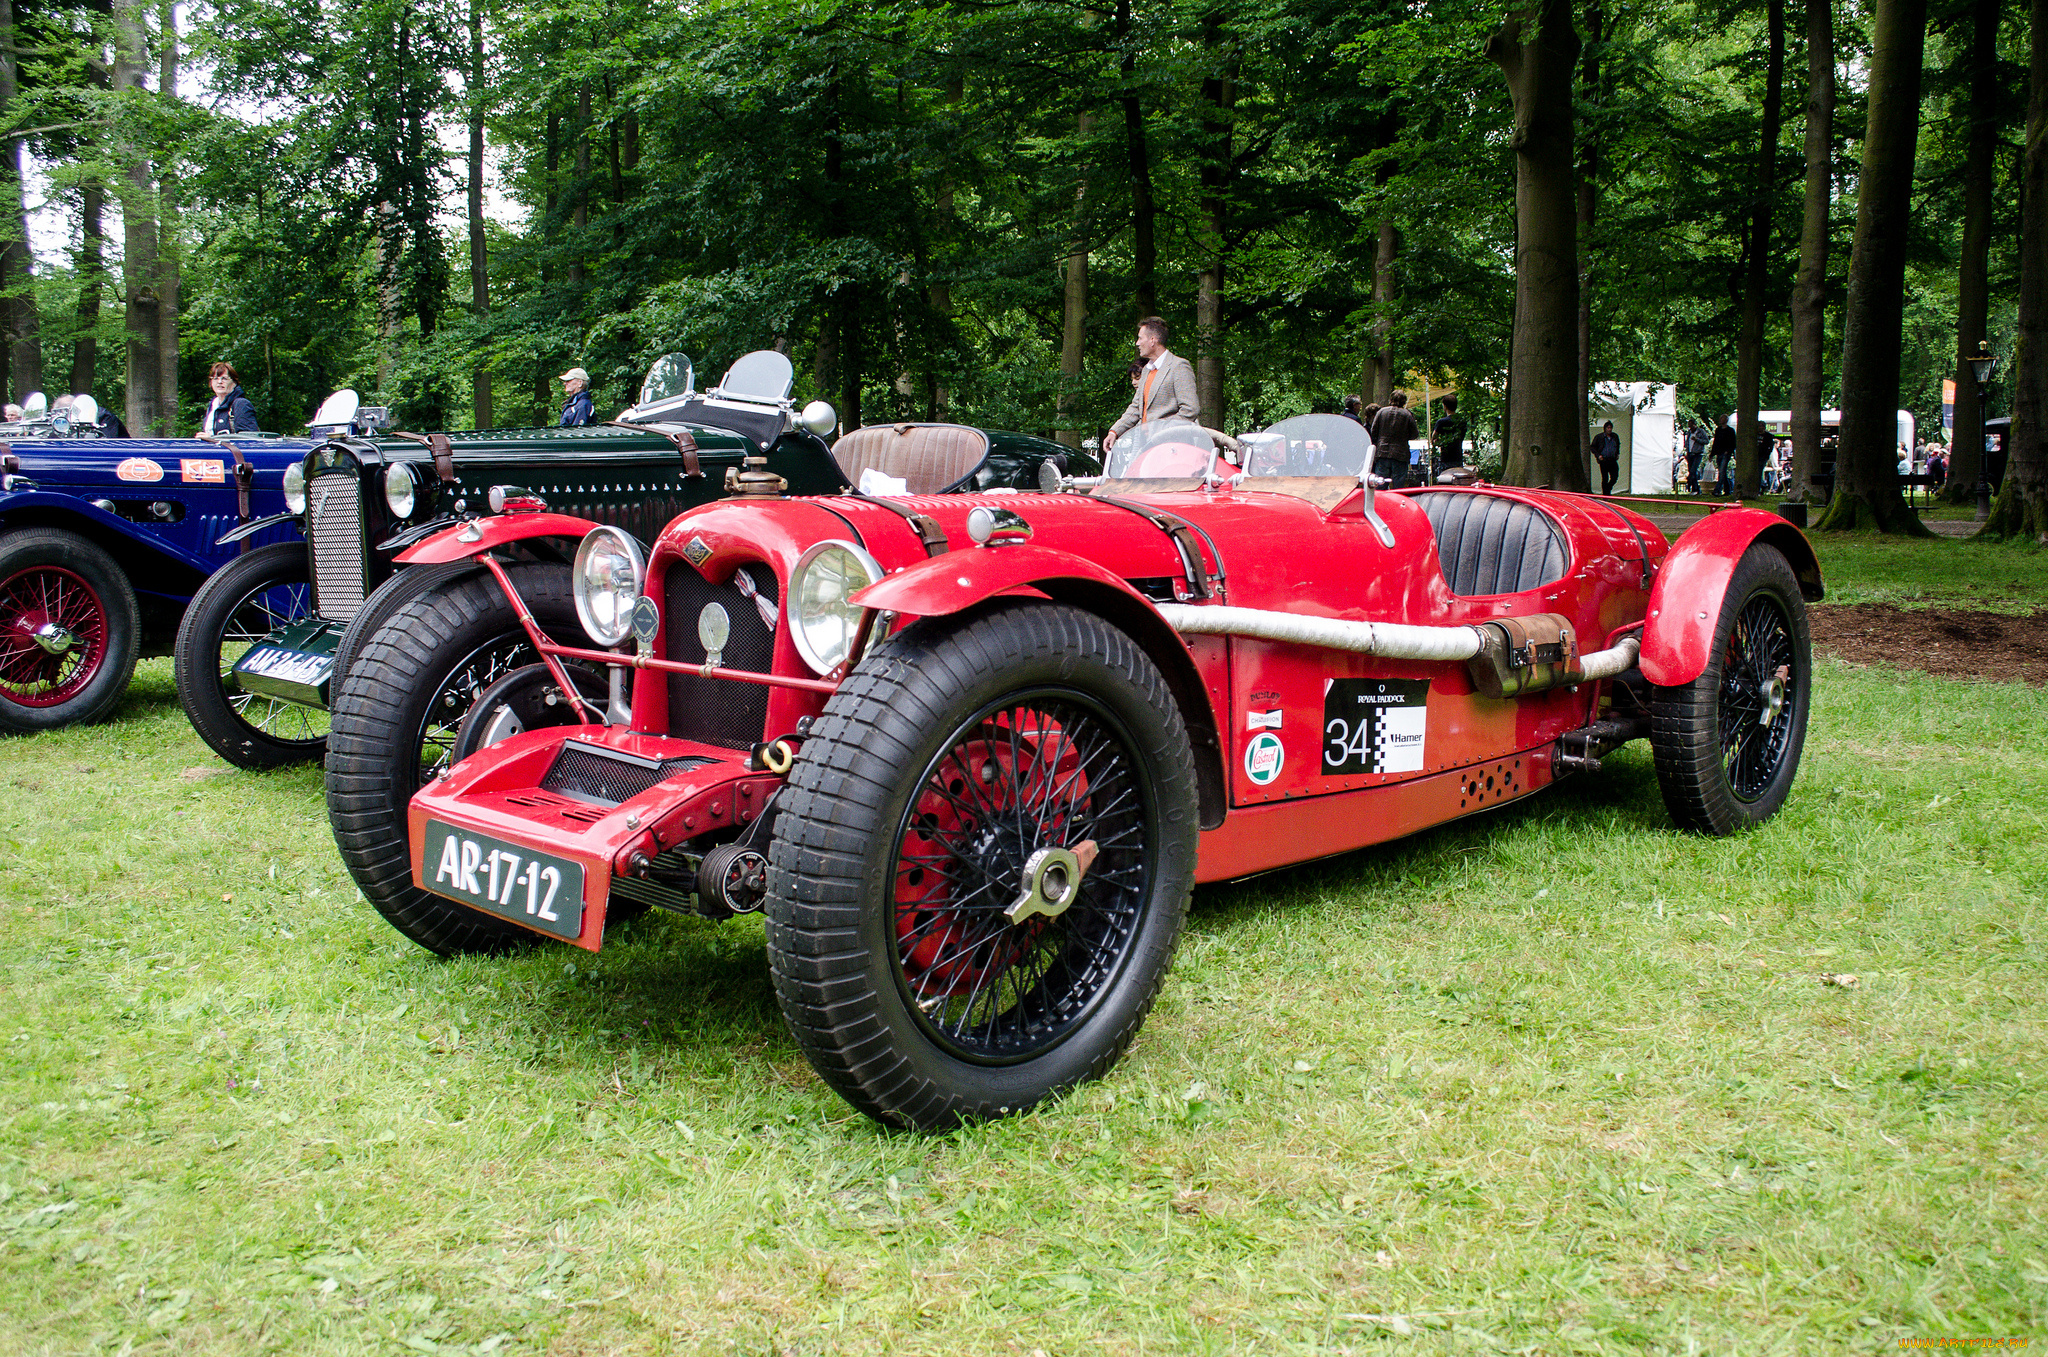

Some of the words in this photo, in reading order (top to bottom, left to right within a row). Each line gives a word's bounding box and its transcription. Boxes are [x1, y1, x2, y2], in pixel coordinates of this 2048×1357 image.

[1357, 695, 1377, 704] ROYAL
[1377, 694, 1405, 703] PADDOCK
[1324, 718, 1371, 767] 34
[1395, 733, 1423, 742] Hamer
[1253, 748, 1276, 770] Castrol
[435, 834, 562, 922] AR-17-12
